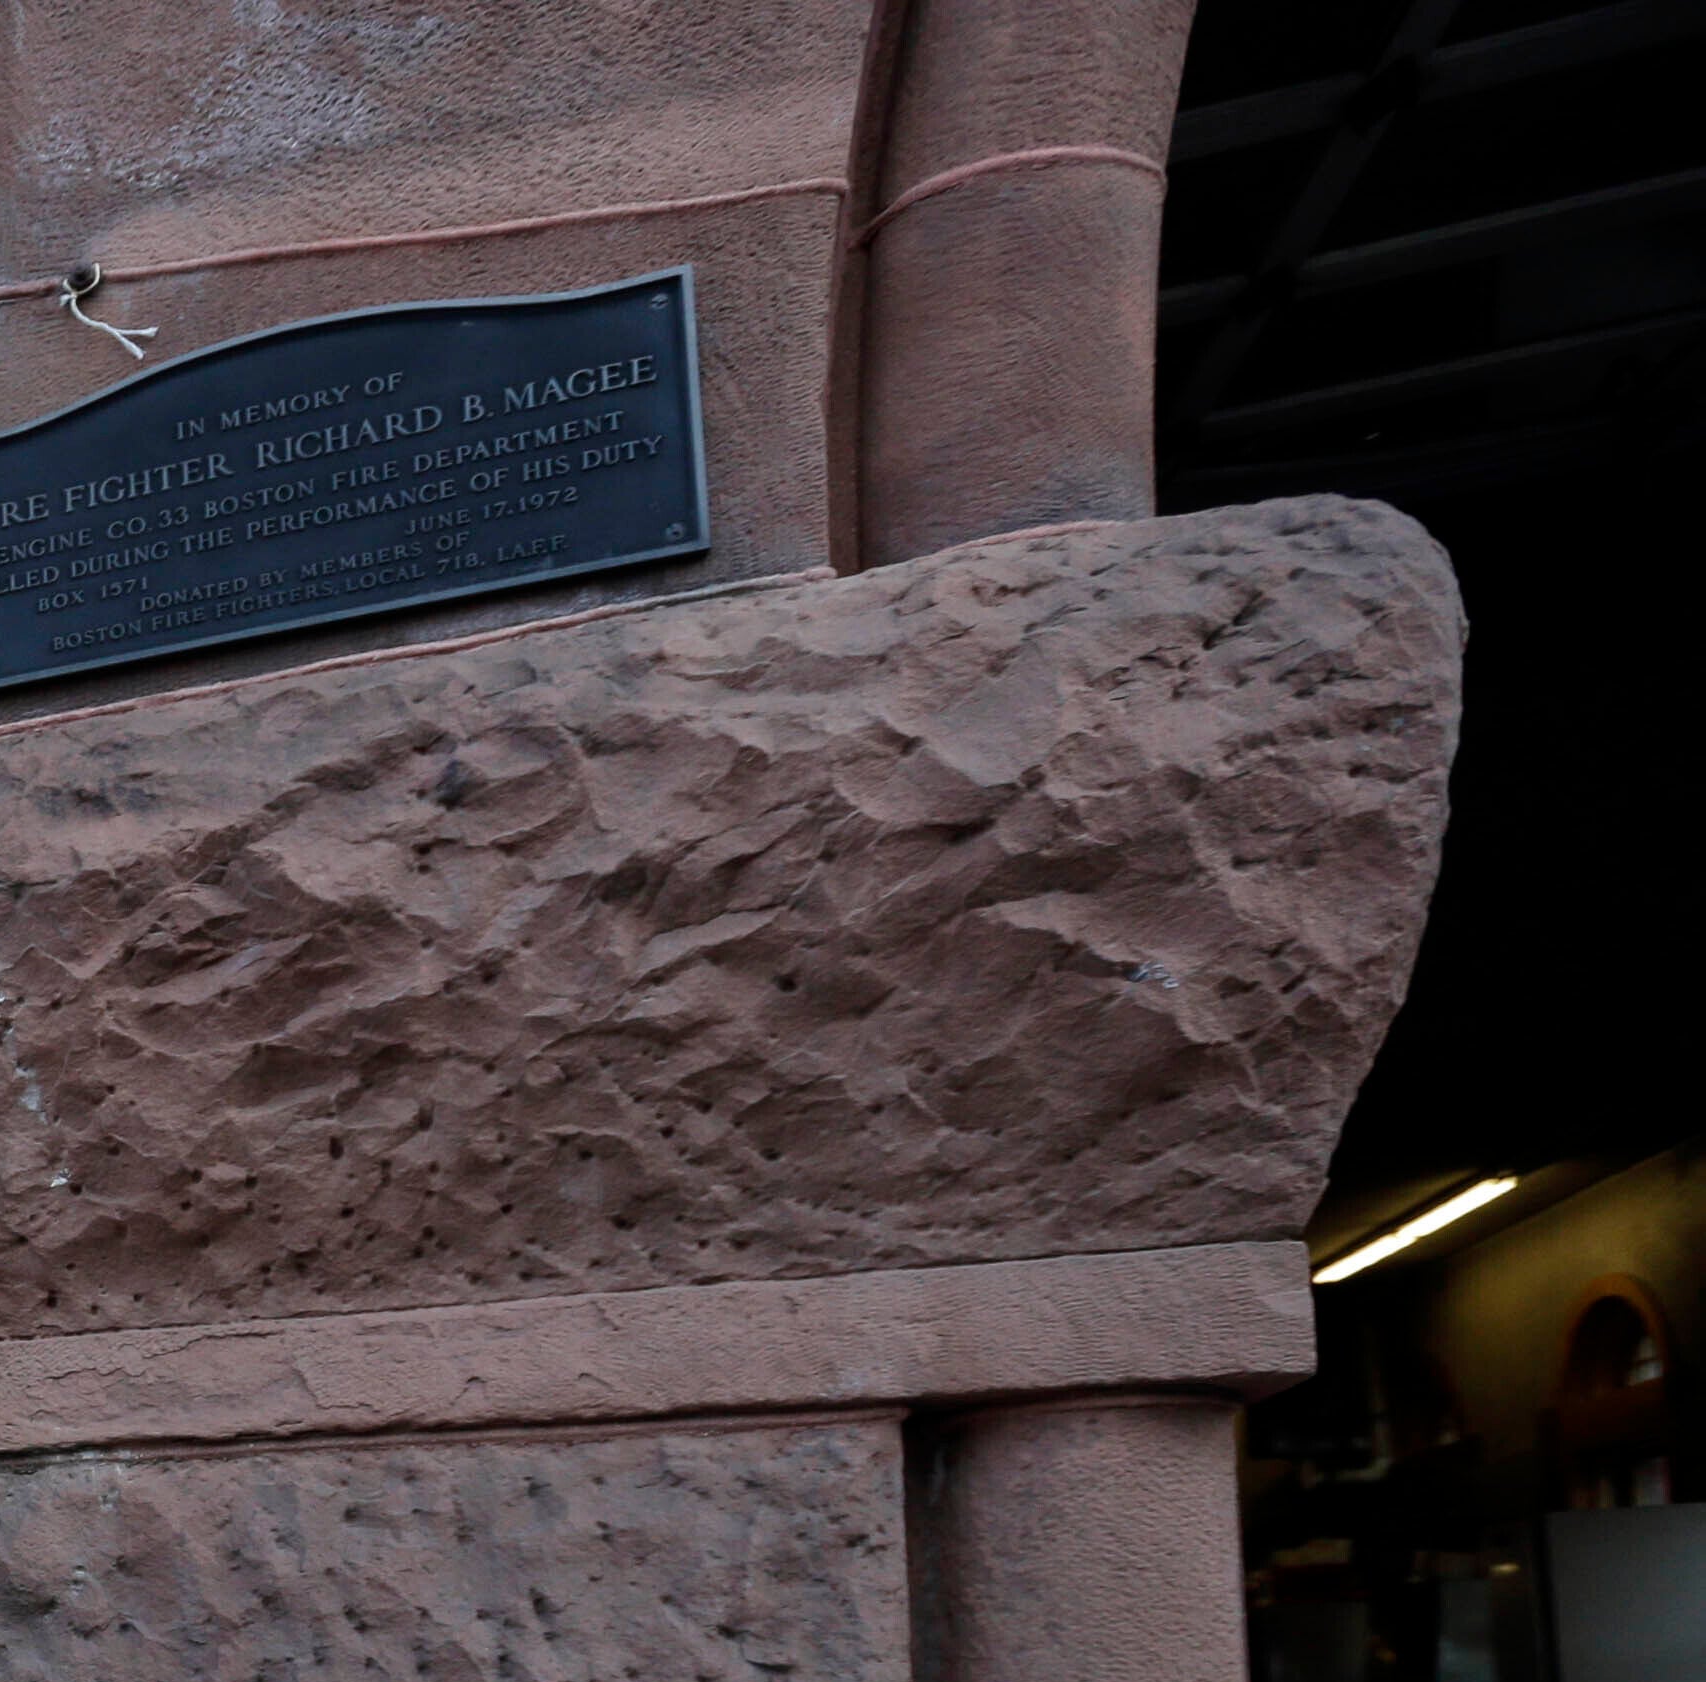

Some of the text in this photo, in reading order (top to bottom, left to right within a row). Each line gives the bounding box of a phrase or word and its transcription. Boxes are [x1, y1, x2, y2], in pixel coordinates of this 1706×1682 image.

[64, 453, 234, 513] FIGHTER
[256, 405, 443, 469] RICHARD
[462, 394, 494, 422] B.
[503, 354, 658, 414] MAGEE
[176, 372, 403, 440] IN MEMORY OF
[71, 541, 168, 577] DURING
[180, 527, 233, 553] THE
[246, 479, 457, 541] PERFORMANCE
[470, 468, 509, 492] OF
[523, 456, 570, 481] HIS
[582, 435, 664, 470] DUTY
[107, 517, 152, 539] CO.
[158, 506, 189, 529] 33
[204, 478, 315, 519] BOSTON
[332, 461, 399, 490] FIRE
[413, 411, 624, 473] DEPARTMENT
[38, 591, 84, 612] BOX
[101, 577, 147, 598] 1571
[404, 509, 471, 535] JUNE
[53, 620, 142, 652] BOSTON
[151, 608, 205, 630] FIRE
[345, 563, 425, 592] LOCAL
[140, 531, 470, 612] DONATED BY MEMBERS OF
